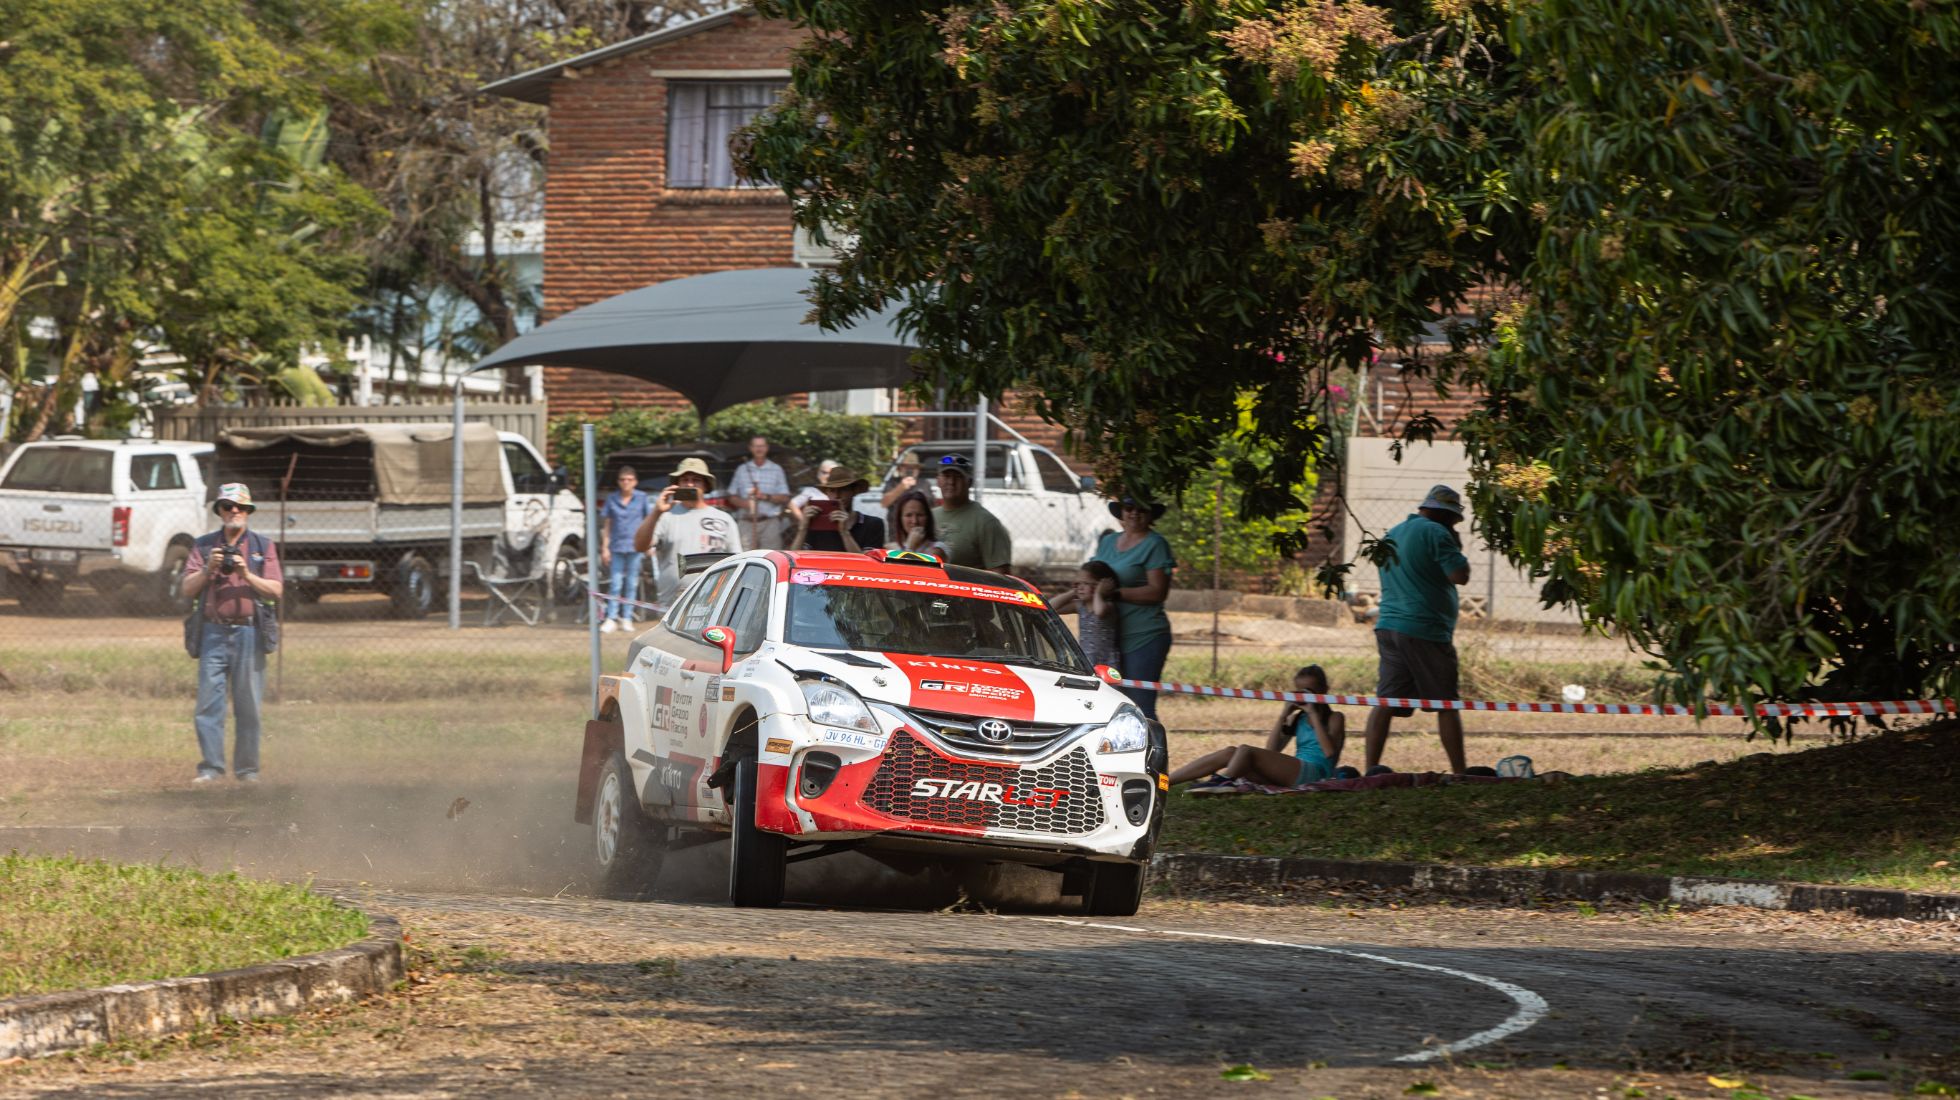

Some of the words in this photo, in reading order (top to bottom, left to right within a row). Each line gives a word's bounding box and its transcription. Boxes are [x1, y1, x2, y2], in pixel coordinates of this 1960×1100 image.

[23, 519, 82, 533] ISUZU
[846, 575, 911, 585] TOYOTA
[913, 580, 971, 591] GAZOO
[908, 661, 1002, 674] KINTO
[921, 682, 967, 692] GR
[673, 691, 692, 706] TOYOTA
[654, 704, 670, 730] GR
[671, 706, 689, 721] GAZOO
[825, 731, 838, 741] JV
[841, 733, 852, 743] 96
[853, 735, 866, 746] HL
[1100, 776, 1116, 786] TOW
[911, 778, 1071, 809] STARLET
